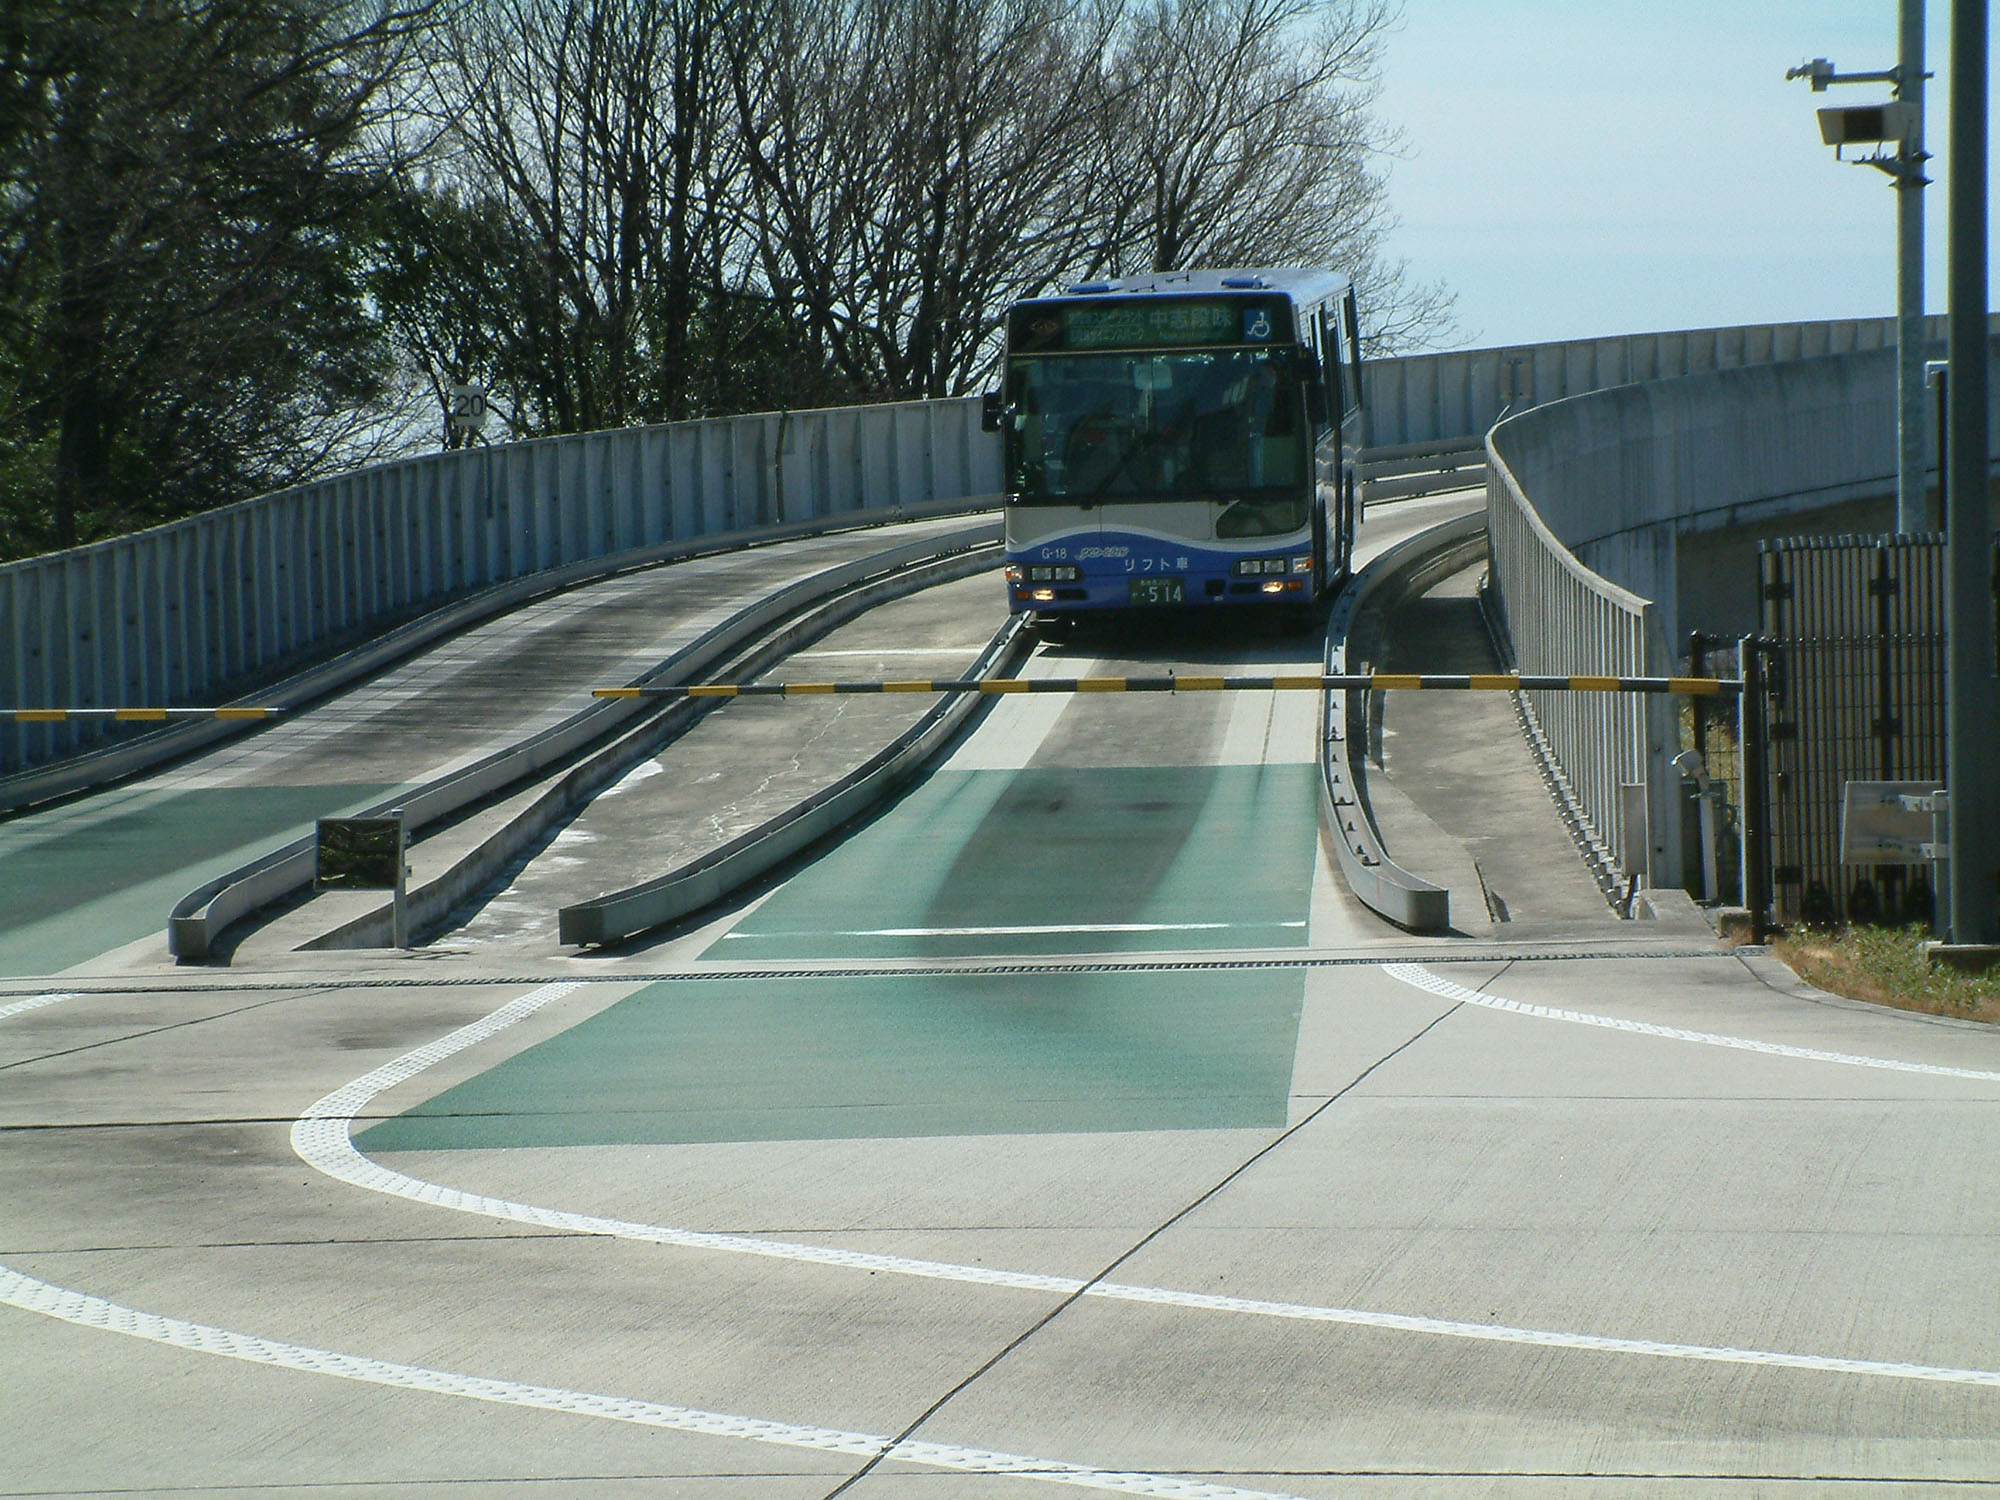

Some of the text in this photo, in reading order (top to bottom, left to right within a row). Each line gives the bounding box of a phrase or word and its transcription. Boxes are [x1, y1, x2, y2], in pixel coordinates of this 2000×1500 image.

[455, 394, 484, 417] 20
[1041, 547, 1067, 560] G-18
[1125, 557, 1189, 572] リフト車
